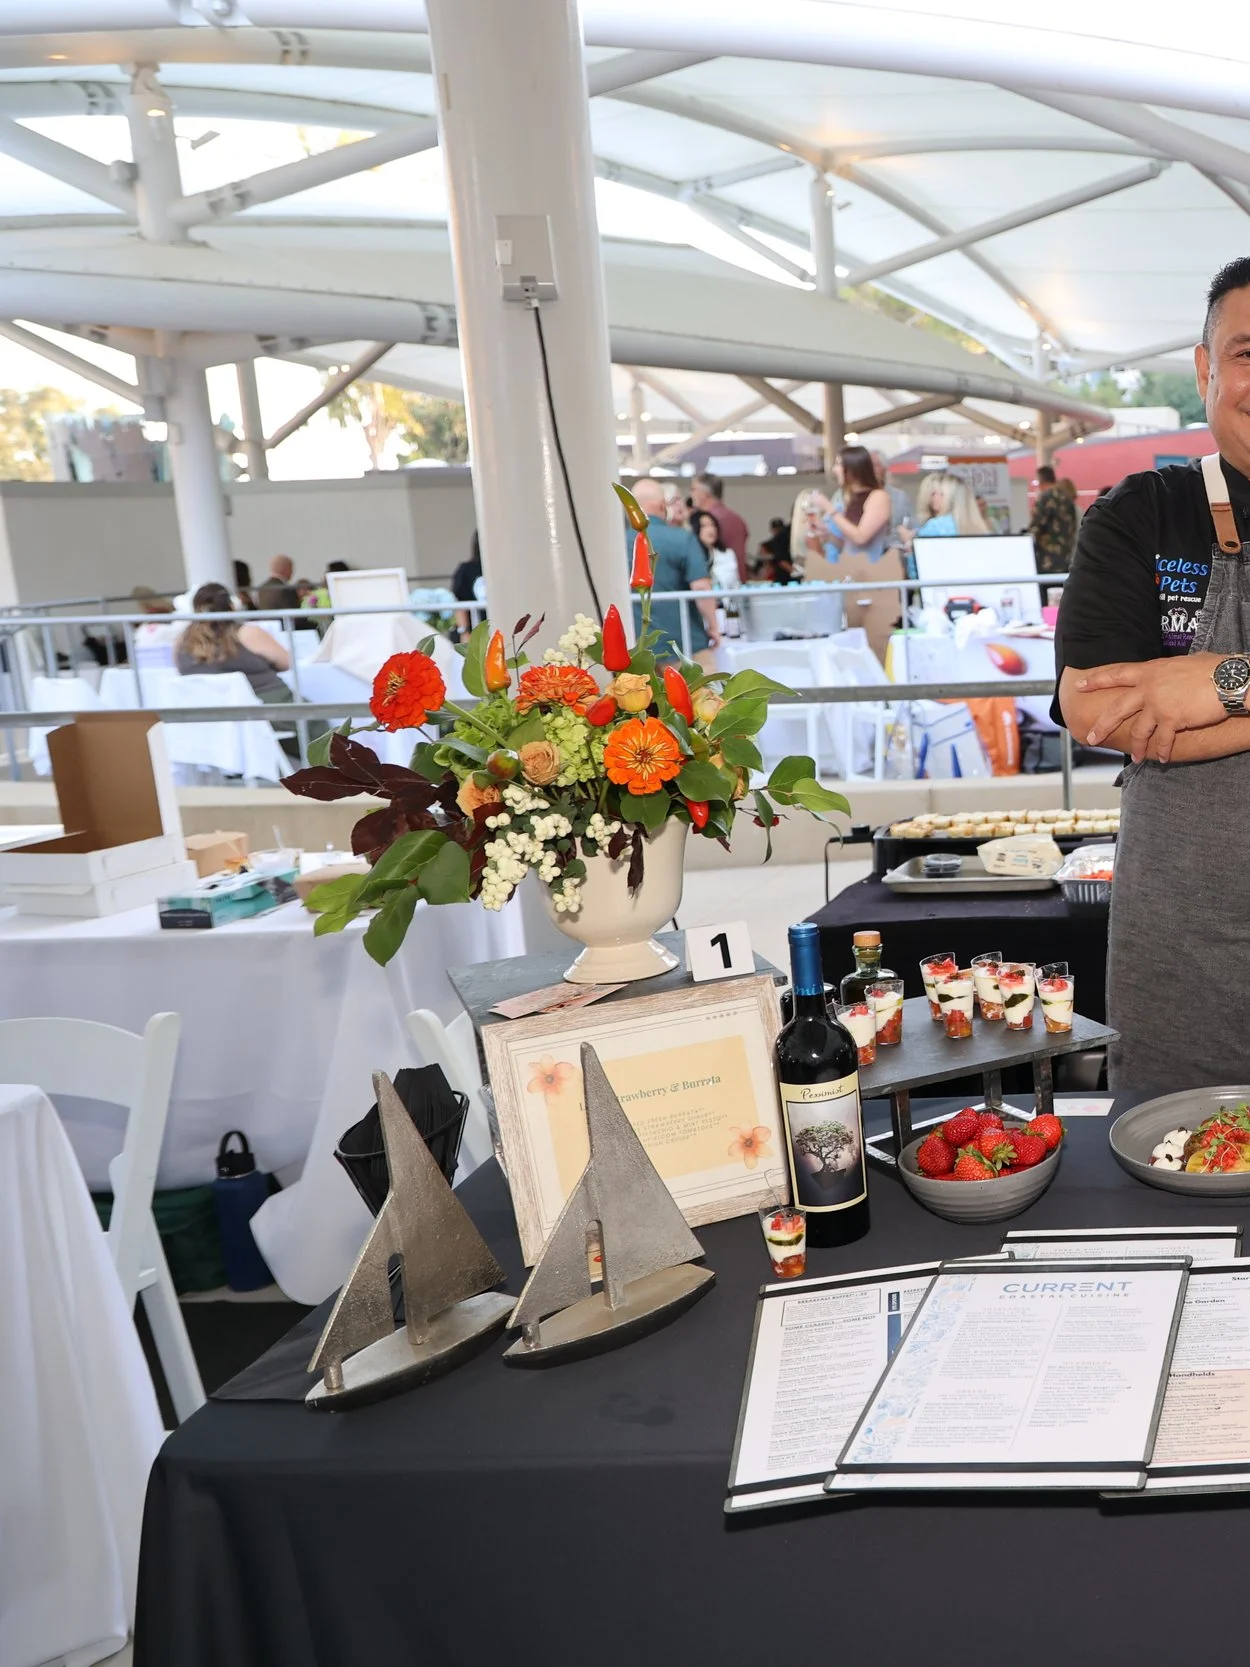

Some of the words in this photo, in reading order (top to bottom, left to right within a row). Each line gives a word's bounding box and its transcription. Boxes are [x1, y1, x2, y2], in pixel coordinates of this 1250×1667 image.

[1160, 575, 1198, 593] Pets
[1180, 595, 1202, 603] rescue
[709, 933, 732, 970] 1
[616, 1087, 667, 1103] trawberry
[669, 1082, 681, 1093] &
[682, 1075, 721, 1091] Burrata
[800, 1085, 845, 1100] Pessimist
[1002, 1281, 1133, 1294] CURRENT
